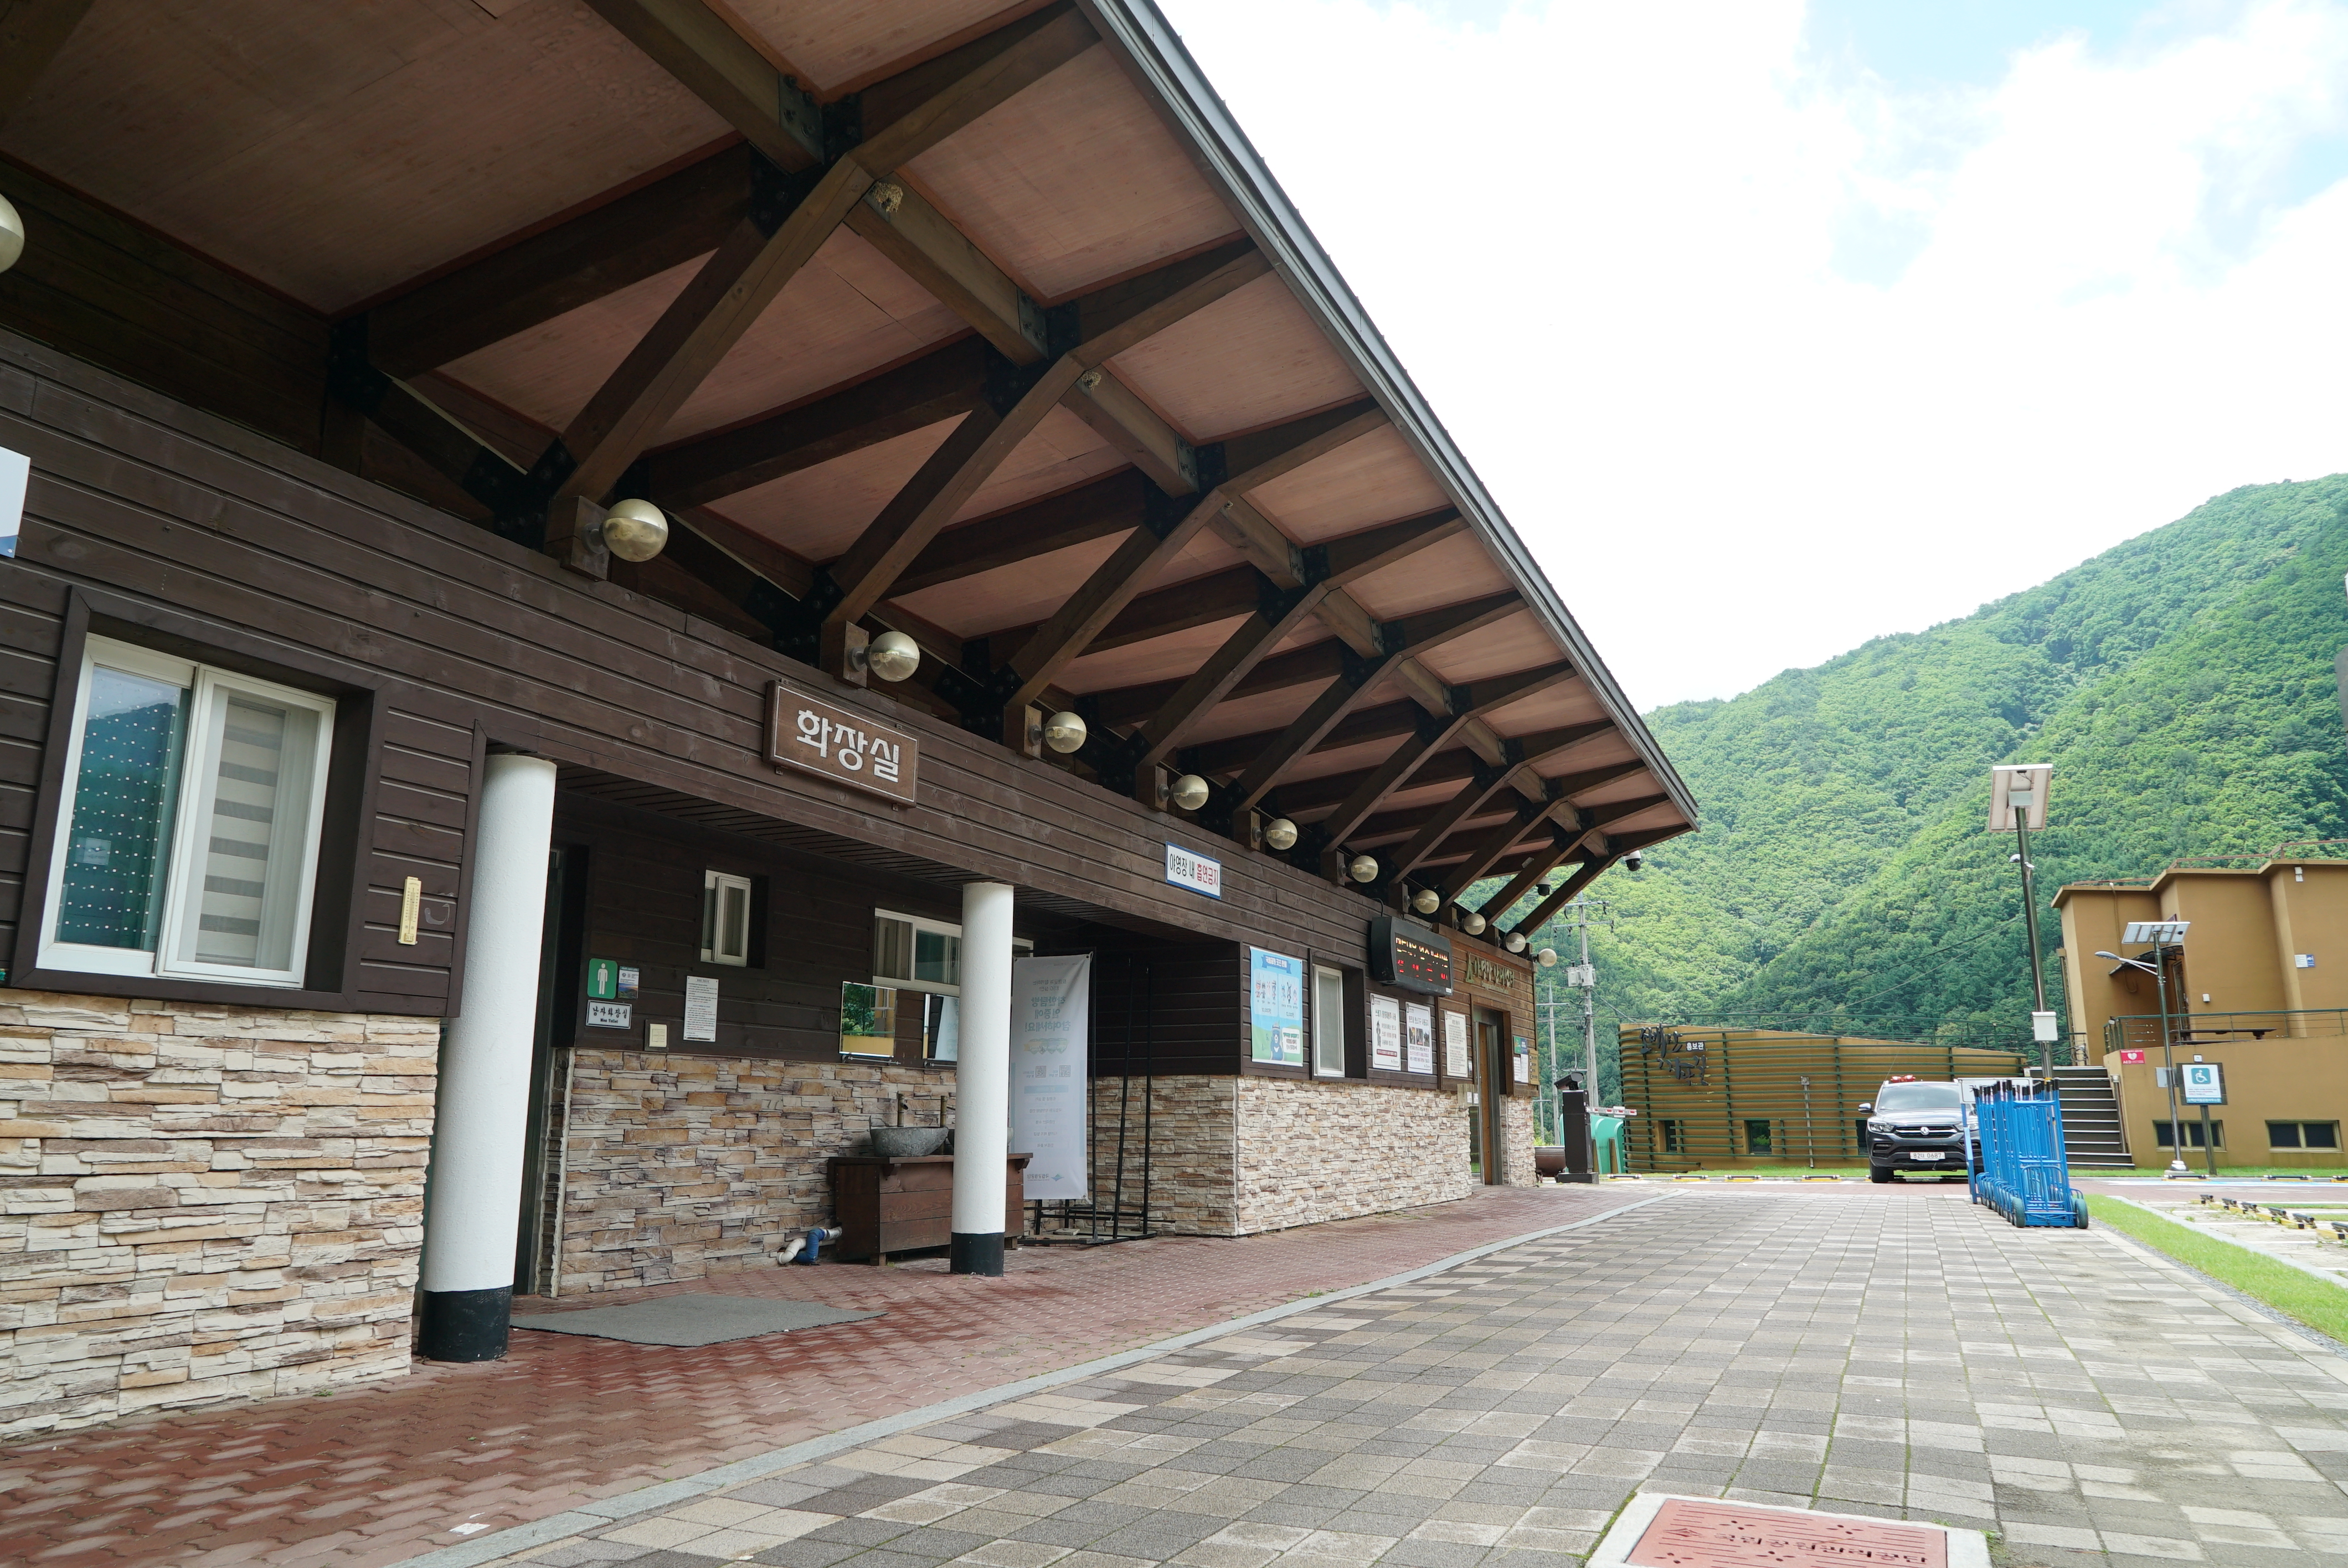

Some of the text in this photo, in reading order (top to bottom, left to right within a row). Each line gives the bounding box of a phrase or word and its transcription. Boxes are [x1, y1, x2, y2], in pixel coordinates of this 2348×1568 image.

[796, 709, 900, 783] 화장실
[1170, 853, 1218, 887] 야영장 내 흡연금지
[593, 1005, 627, 1019] 남자화장실
[1686, 1041, 1705, 1051] 홍보관
[1714, 1533, 1927, 1565] 국립공원관리공단
